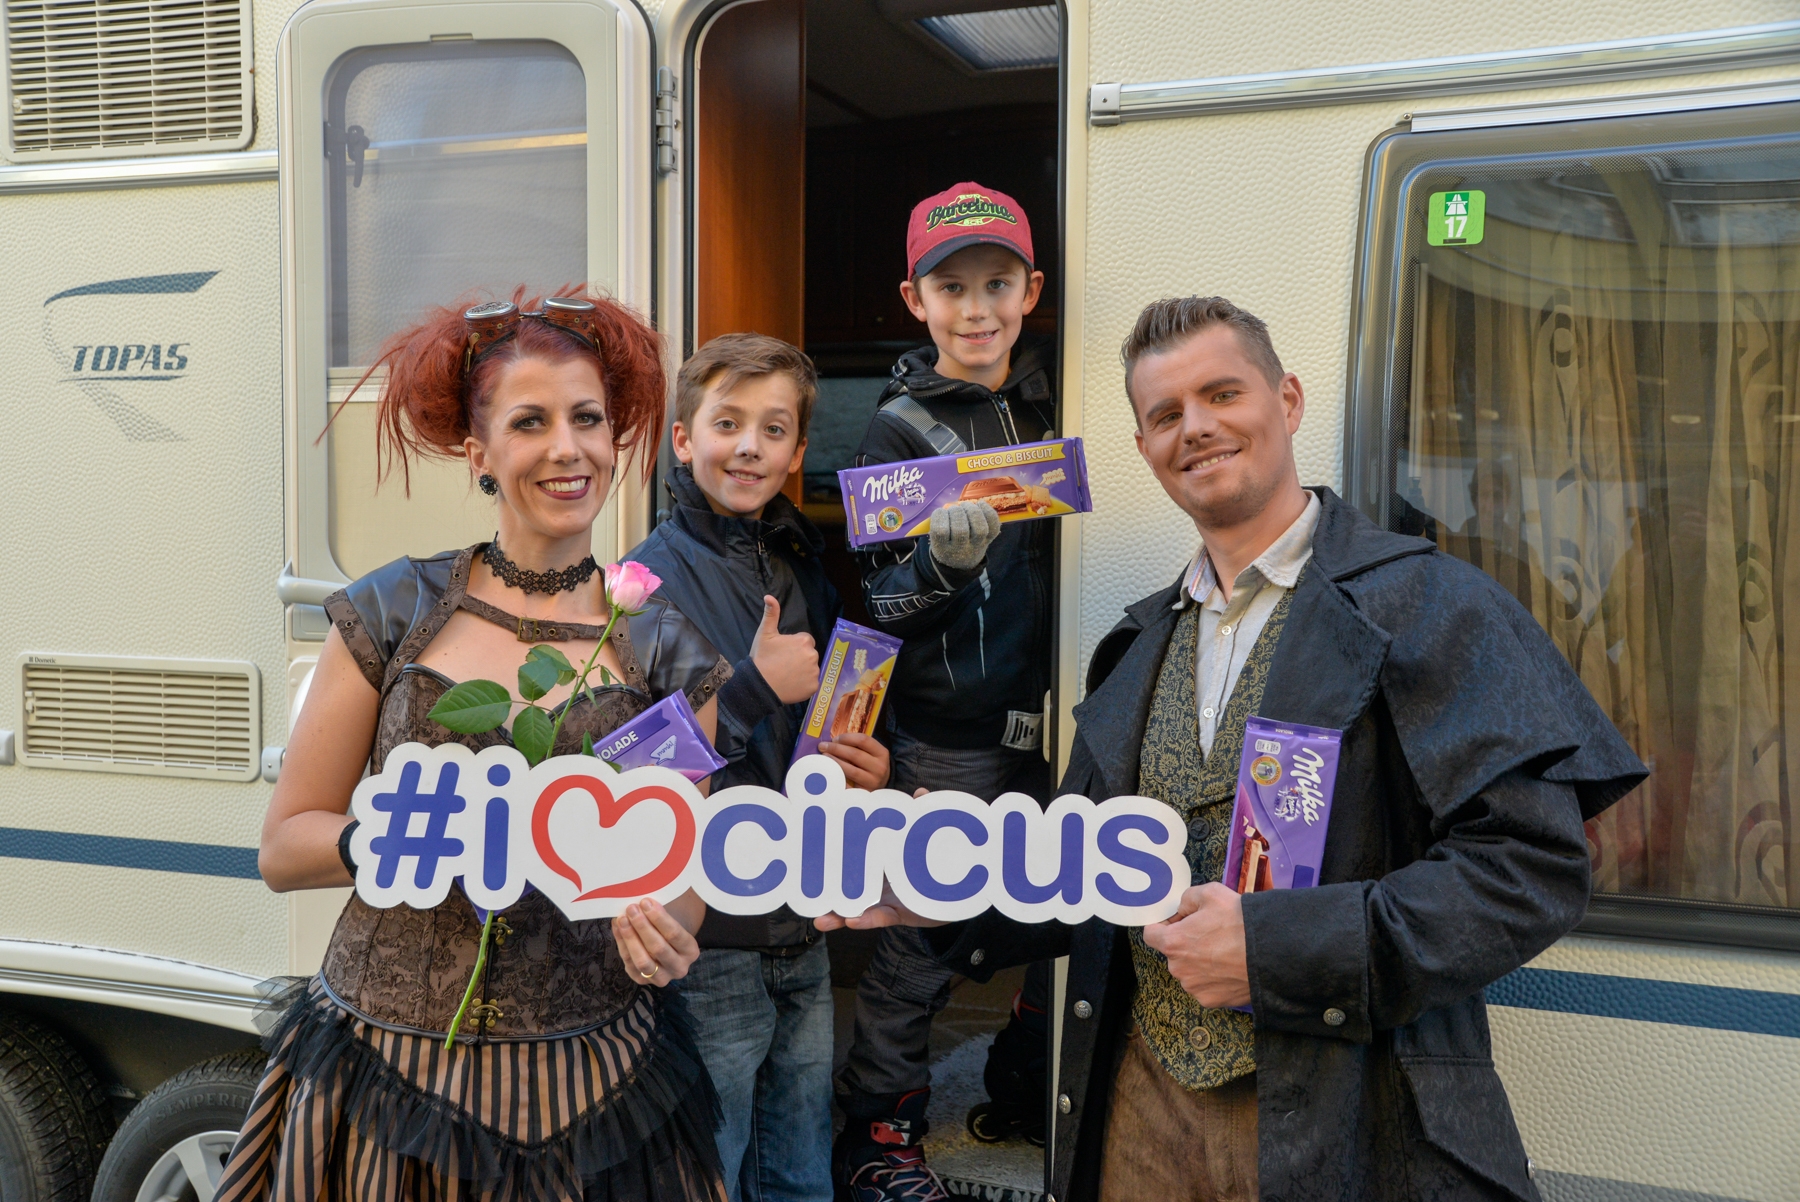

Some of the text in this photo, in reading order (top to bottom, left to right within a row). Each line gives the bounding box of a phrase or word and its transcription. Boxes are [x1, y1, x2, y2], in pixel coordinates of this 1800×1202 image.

[927, 197, 1017, 232] Barcelona
[1445, 216, 1468, 238] 17
[73, 343, 190, 372] TOPAS
[967, 448, 1053, 469] CHOCO & BISCUIT
[862, 466, 925, 503] Milka
[34, 656, 56, 664] Dometic
[812, 695, 828, 727] CHOCO
[826, 649, 843, 684] BISCUIT
[1290, 747, 1325, 827] Milka
[701, 772, 1173, 907] circus
[156, 1092, 251, 1121] SEMPERIT
